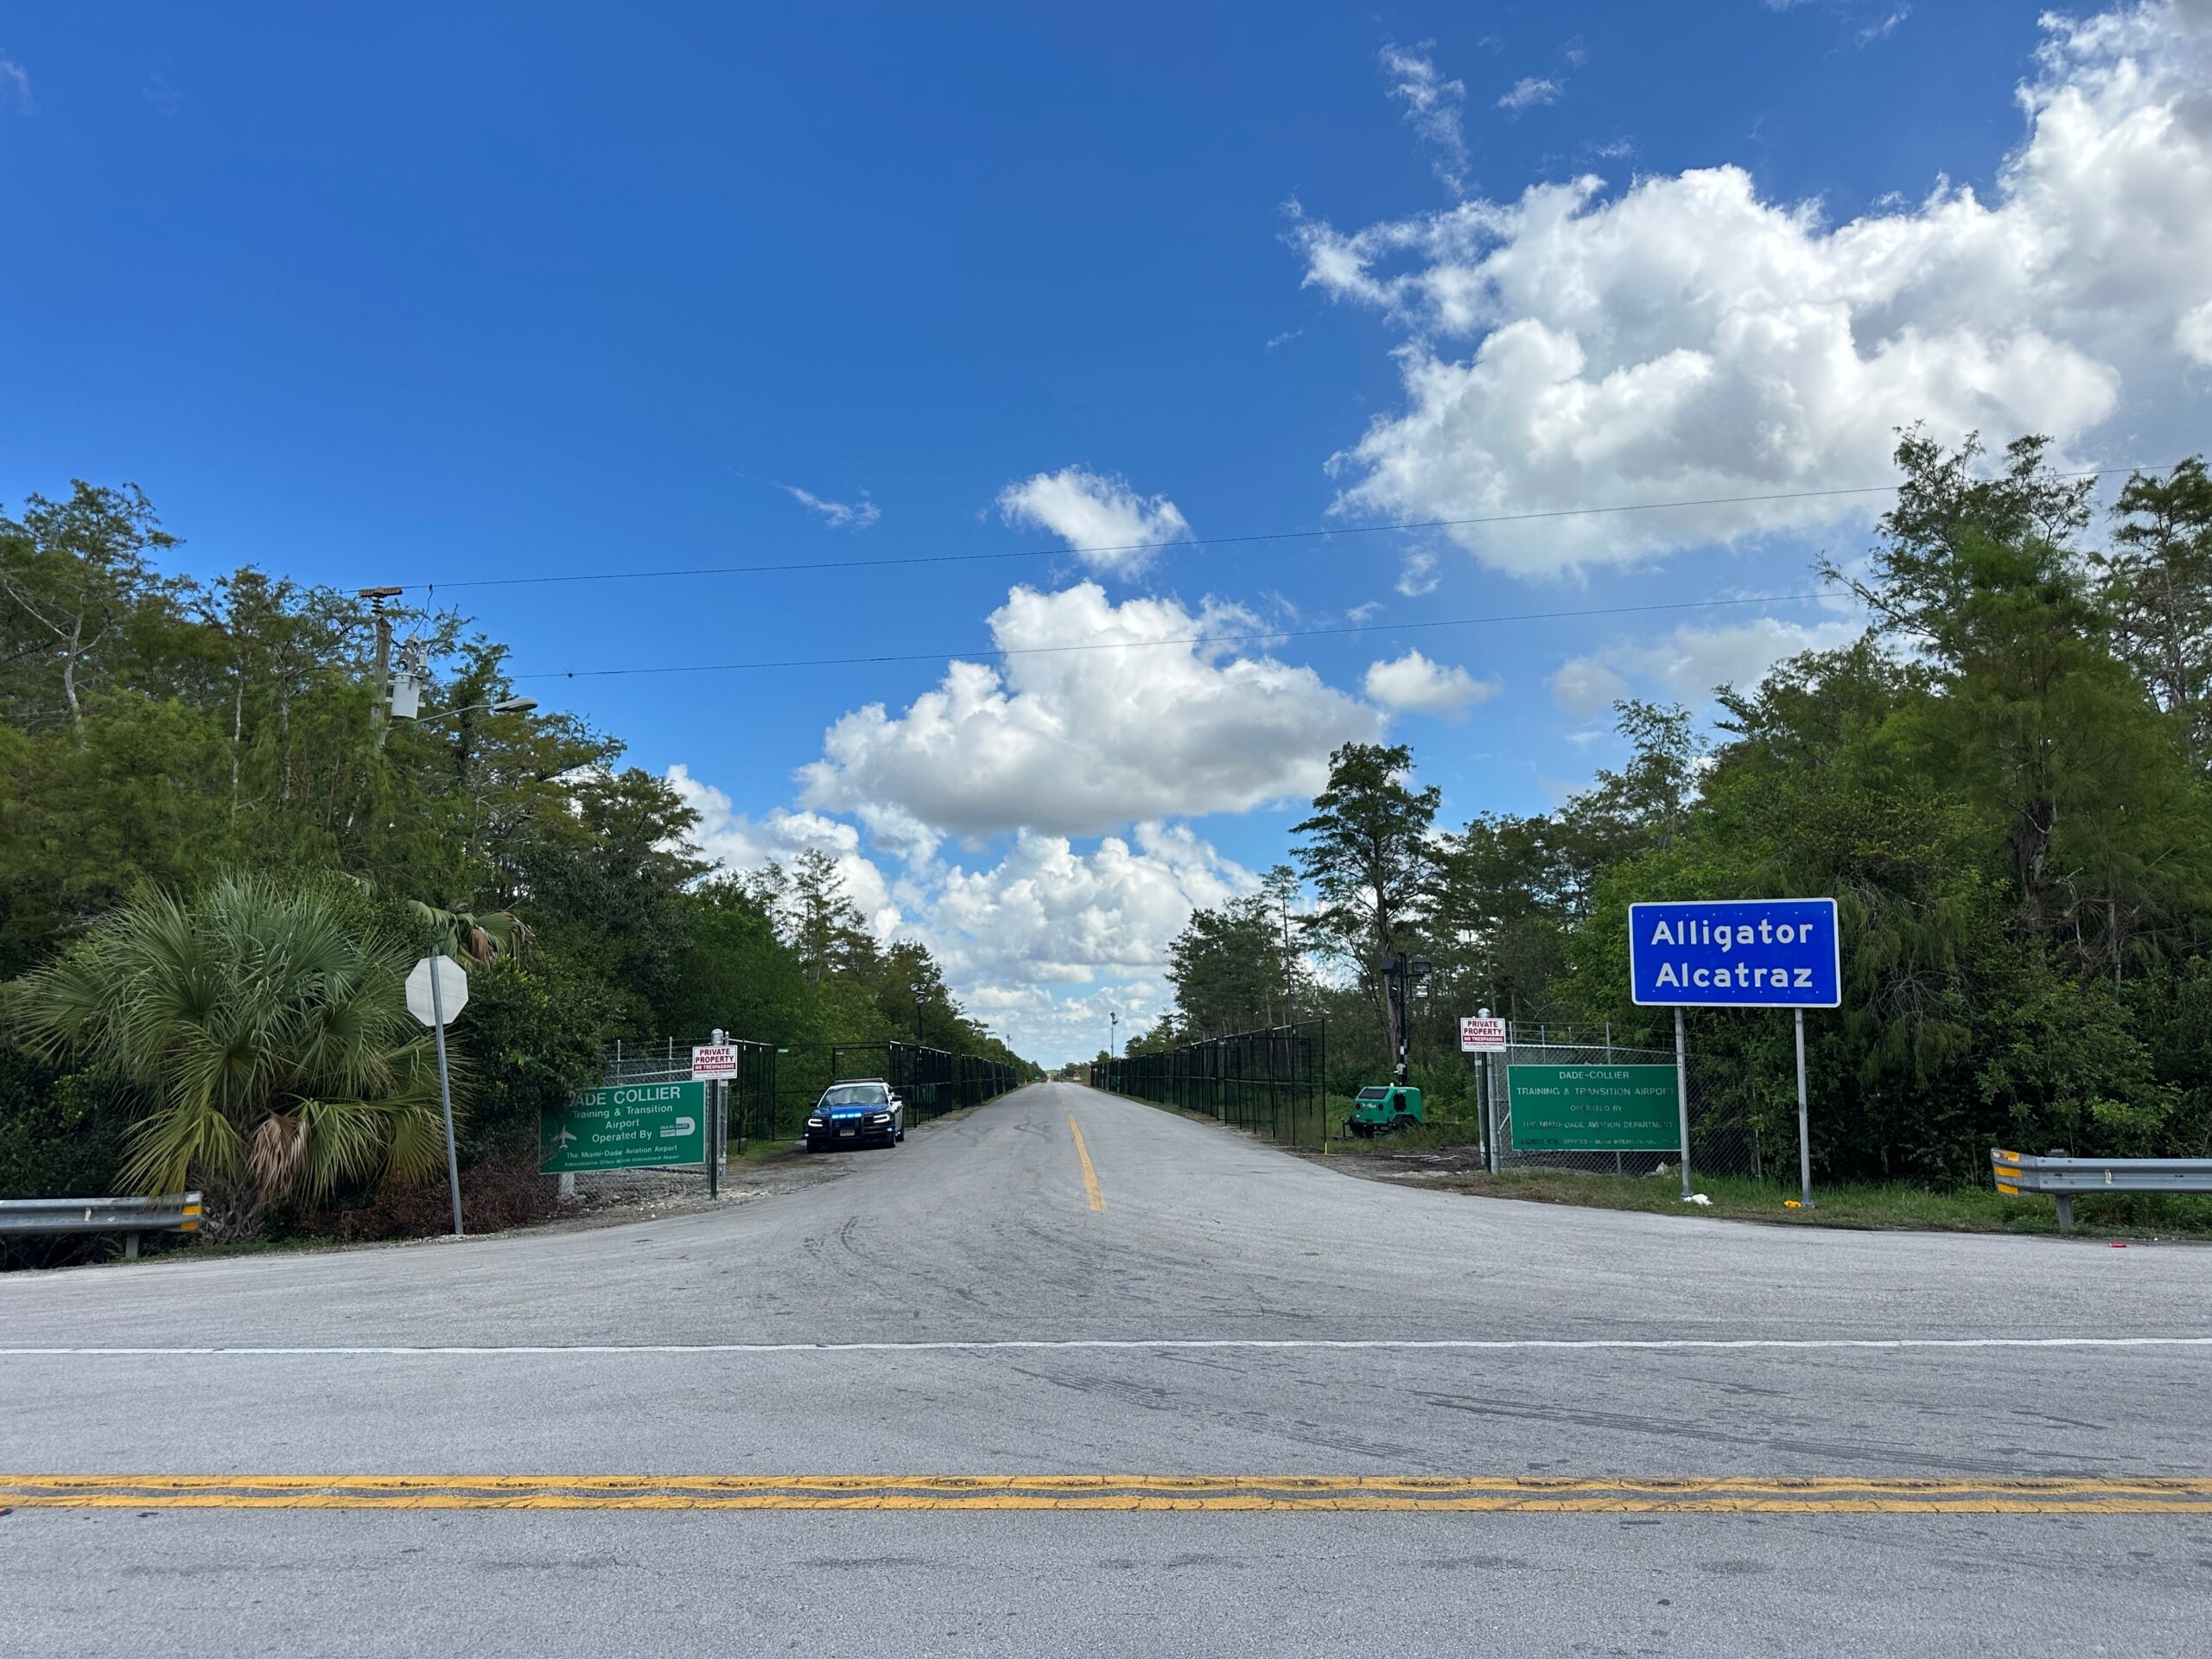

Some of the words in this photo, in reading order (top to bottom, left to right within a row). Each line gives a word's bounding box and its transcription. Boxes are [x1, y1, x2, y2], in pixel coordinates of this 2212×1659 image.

[1650, 918, 1814, 953] Alligator
[1656, 962, 1813, 988] Alcatraz
[696, 1055, 734, 1064] PROPERTY
[1559, 1071, 1630, 1079] DADE-COLLIER
[613, 1086, 681, 1105] COLLIER
[1516, 1087, 1560, 1096] TRAINING
[1564, 1087, 1570, 1096] &
[1575, 1087, 1631, 1096] TRANSITION
[571, 1109, 610, 1119] Training
[613, 1108, 621, 1117] &
[626, 1104, 673, 1116] Transition
[605, 1118, 639, 1130] Airport
[592, 1131, 637, 1144] Operated
[639, 1130, 652, 1141] By
[581, 1149, 622, 1159] Miami-Dade
